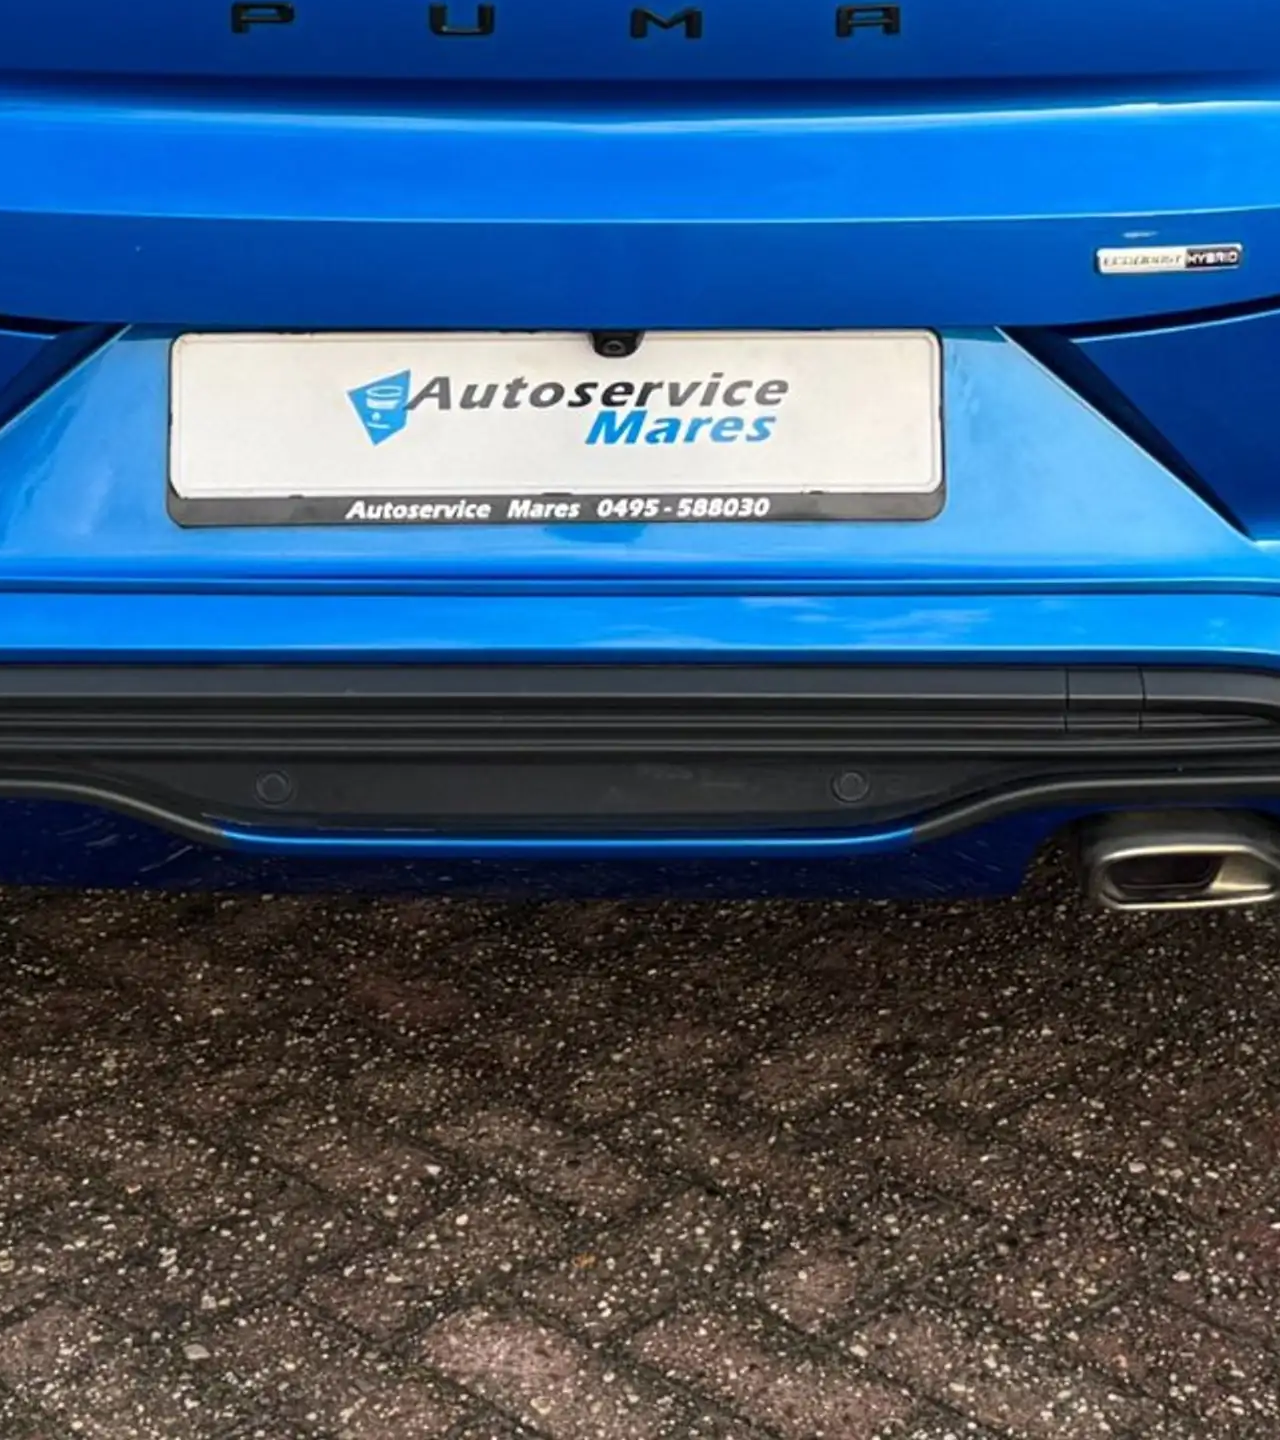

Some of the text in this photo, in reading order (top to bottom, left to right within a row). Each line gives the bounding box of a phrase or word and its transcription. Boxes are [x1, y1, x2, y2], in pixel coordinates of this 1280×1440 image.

[230, 2, 902, 40] PUMA
[407, 372, 789, 410] Autoservice
[585, 410, 777, 445] Mares
[345, 499, 491, 521] Autoservice
[507, 499, 581, 519] Mares
